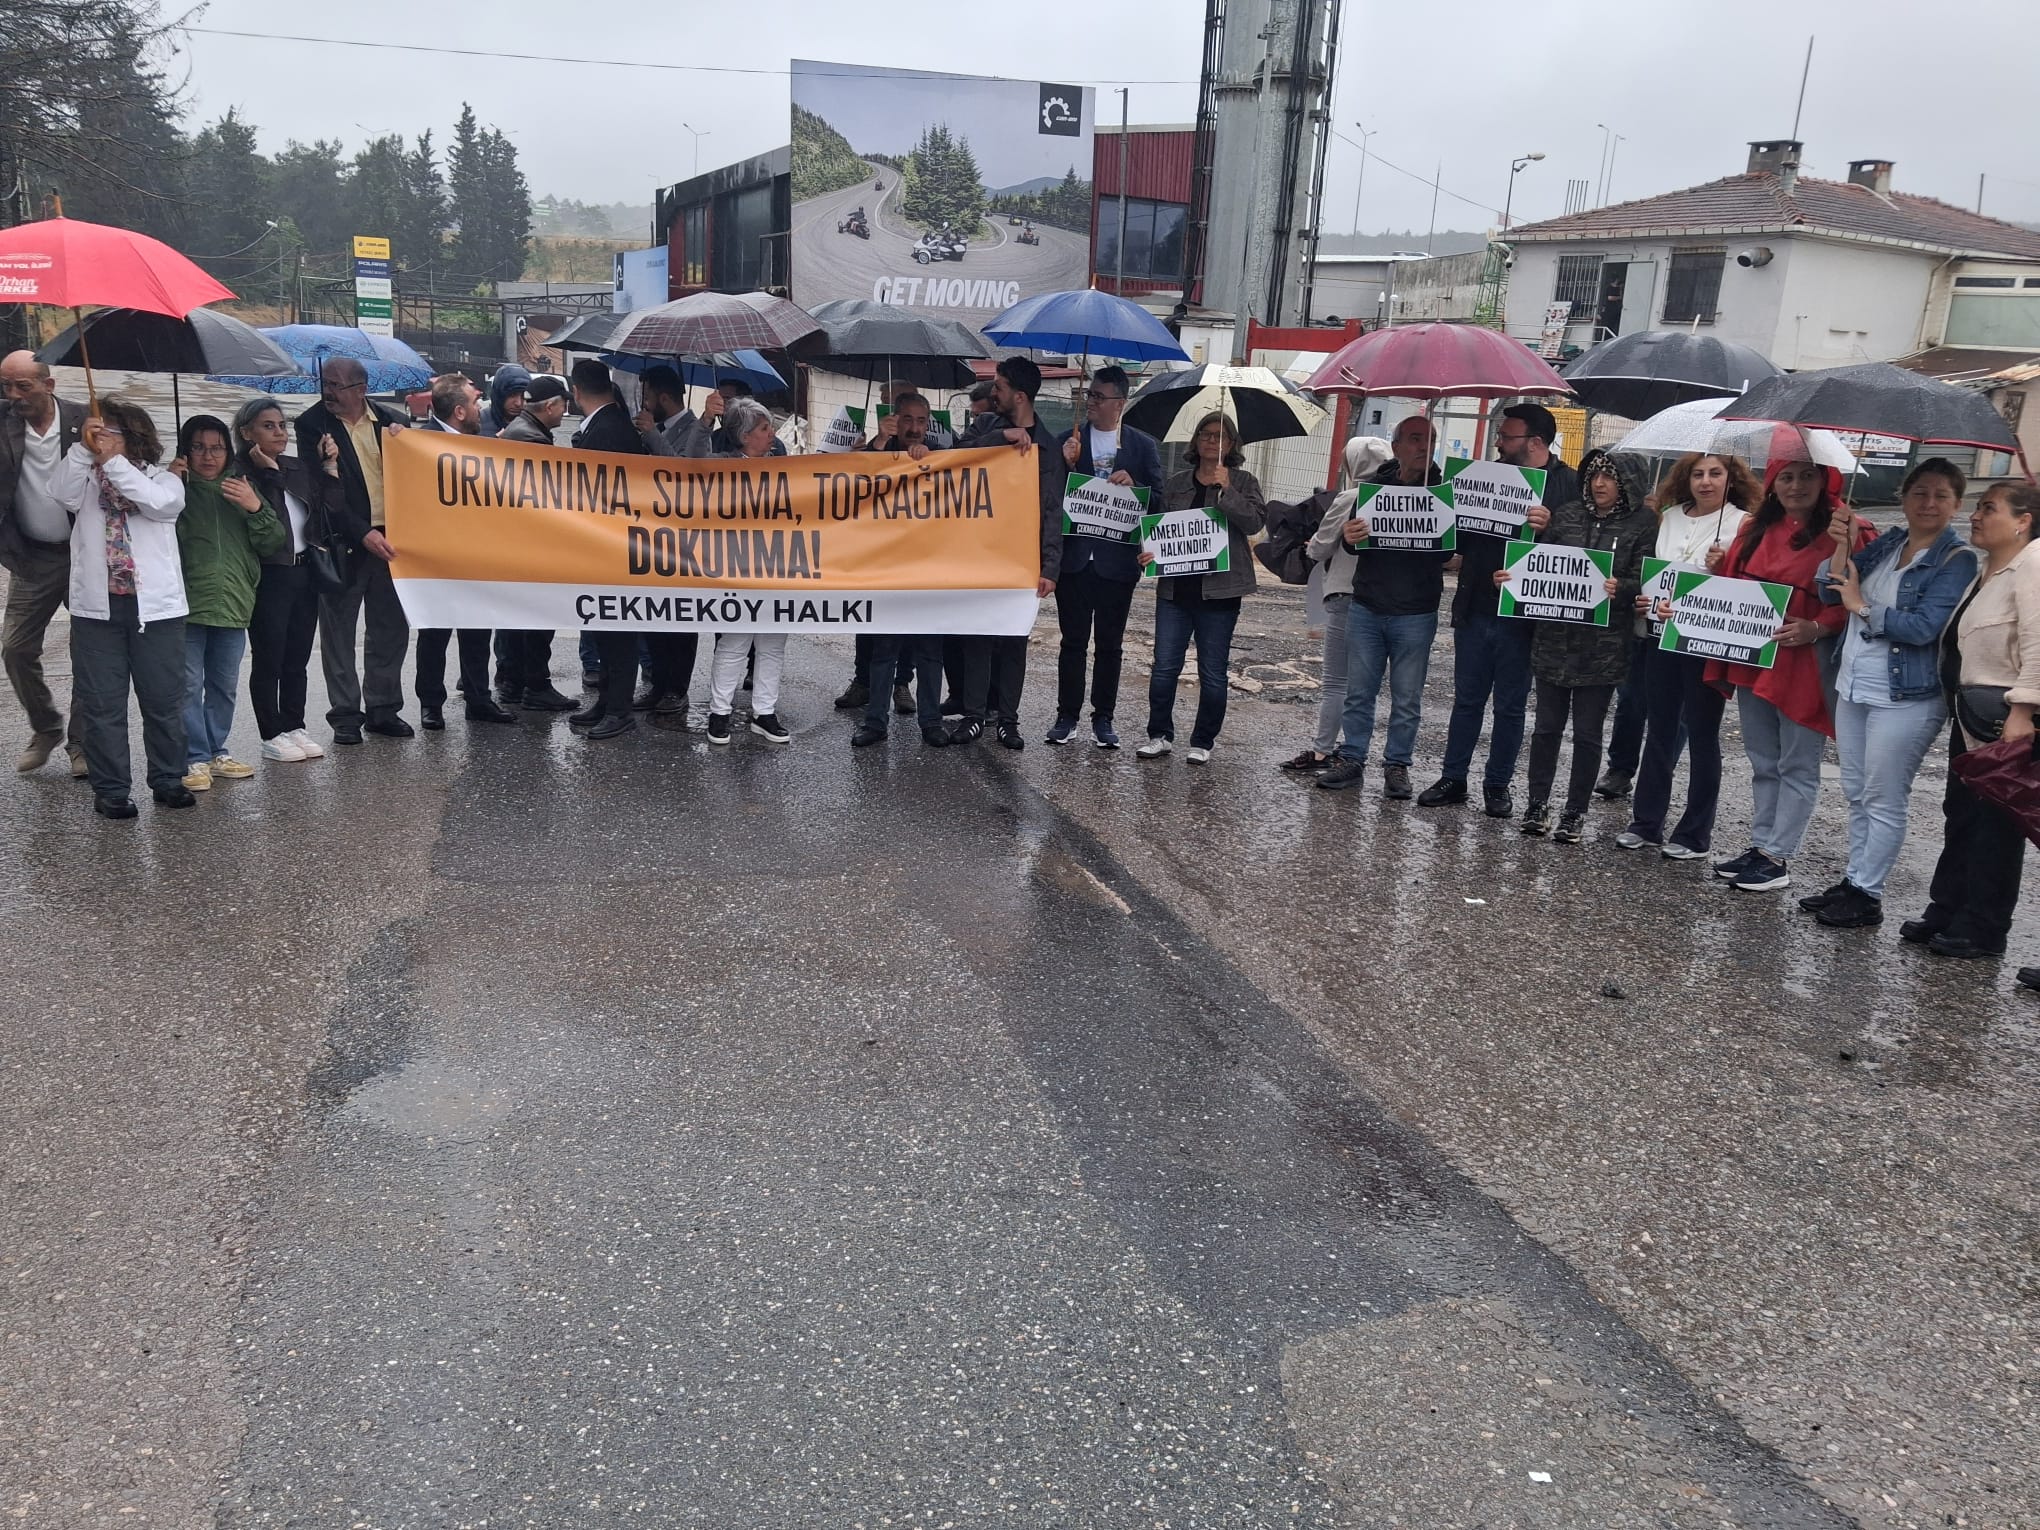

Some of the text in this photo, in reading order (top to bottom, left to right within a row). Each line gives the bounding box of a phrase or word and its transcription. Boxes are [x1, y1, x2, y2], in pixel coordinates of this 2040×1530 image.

[0, 285, 39, 293] ERKEZ
[873, 276, 1020, 309] GET MOVING
[437, 453, 994, 525] ORMANIMA, SUYUMA, TOPRAĞIMA
[1453, 477, 1533, 501] RMANIMA, SUYUMA
[1069, 502, 1139, 525] SERMAYE DEĞİLDİR!
[1375, 493, 1434, 512] GÖLETİME
[1454, 493, 1529, 516] PRAĞIMA DOKUNM
[1150, 520, 1185, 541] ÖMERLİ
[1372, 517, 1438, 533] DOKUNMA!
[1458, 517, 1512, 535] ÇEKMEKÖY HALKI
[628, 525, 822, 579] DOKUNMA!
[1160, 537, 1211, 558] HALKINDIR!
[1377, 537, 1432, 549] ÇEKMEKÖY HALKI
[1527, 552, 1590, 578] GÖLETİME
[1521, 578, 1592, 603] DOKUNMA!
[576, 592, 873, 625] ÇEKMEKÖY HALKI
[1524, 604, 1584, 620] ÇEKMEKÖY HALKI
[1681, 594, 1734, 616] ORMANIMA,
[1737, 602, 1775, 621] SUYUMA
[1672, 610, 1725, 631] TOPRAĞIMA
[1728, 619, 1776, 638] DOKUNMA!
[1687, 640, 1750, 660] ÇEKMEKÖY HALKI
